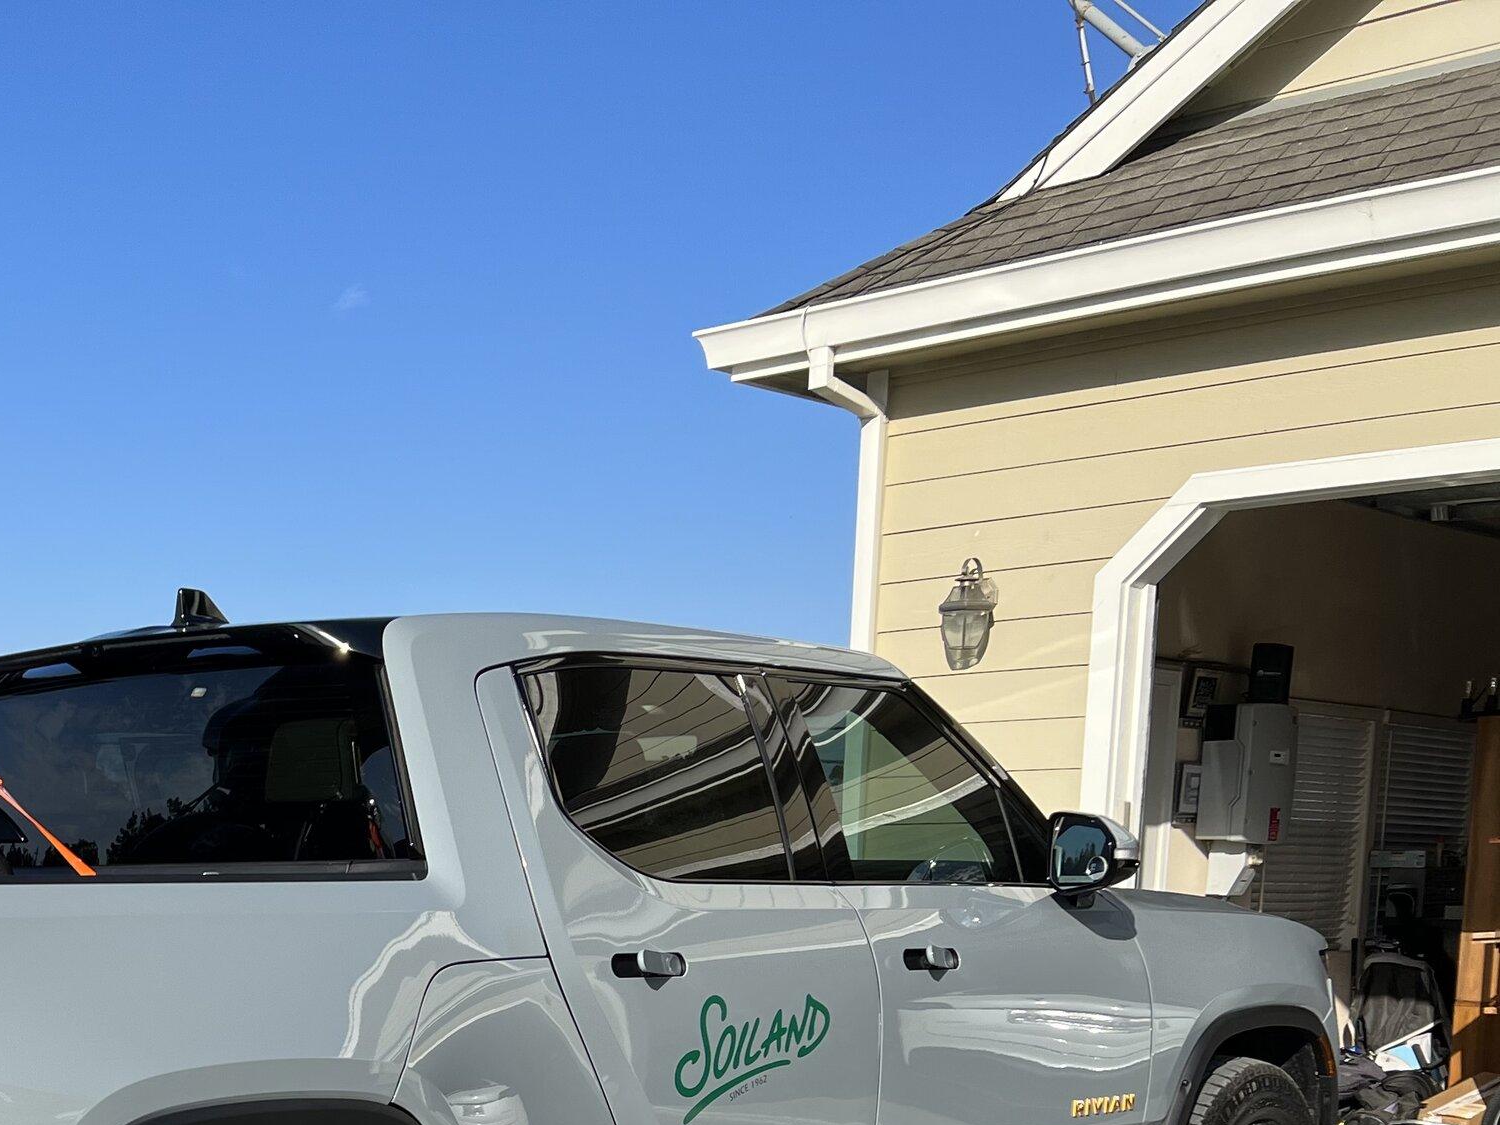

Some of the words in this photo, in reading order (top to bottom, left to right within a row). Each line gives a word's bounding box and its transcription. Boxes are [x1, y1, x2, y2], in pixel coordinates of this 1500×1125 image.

[674, 993, 831, 1098] SOILAND
[729, 1083, 749, 1101] SINCE
[751, 1074, 768, 1088] 1962
[1071, 1093, 1136, 1118] RIVIAN
